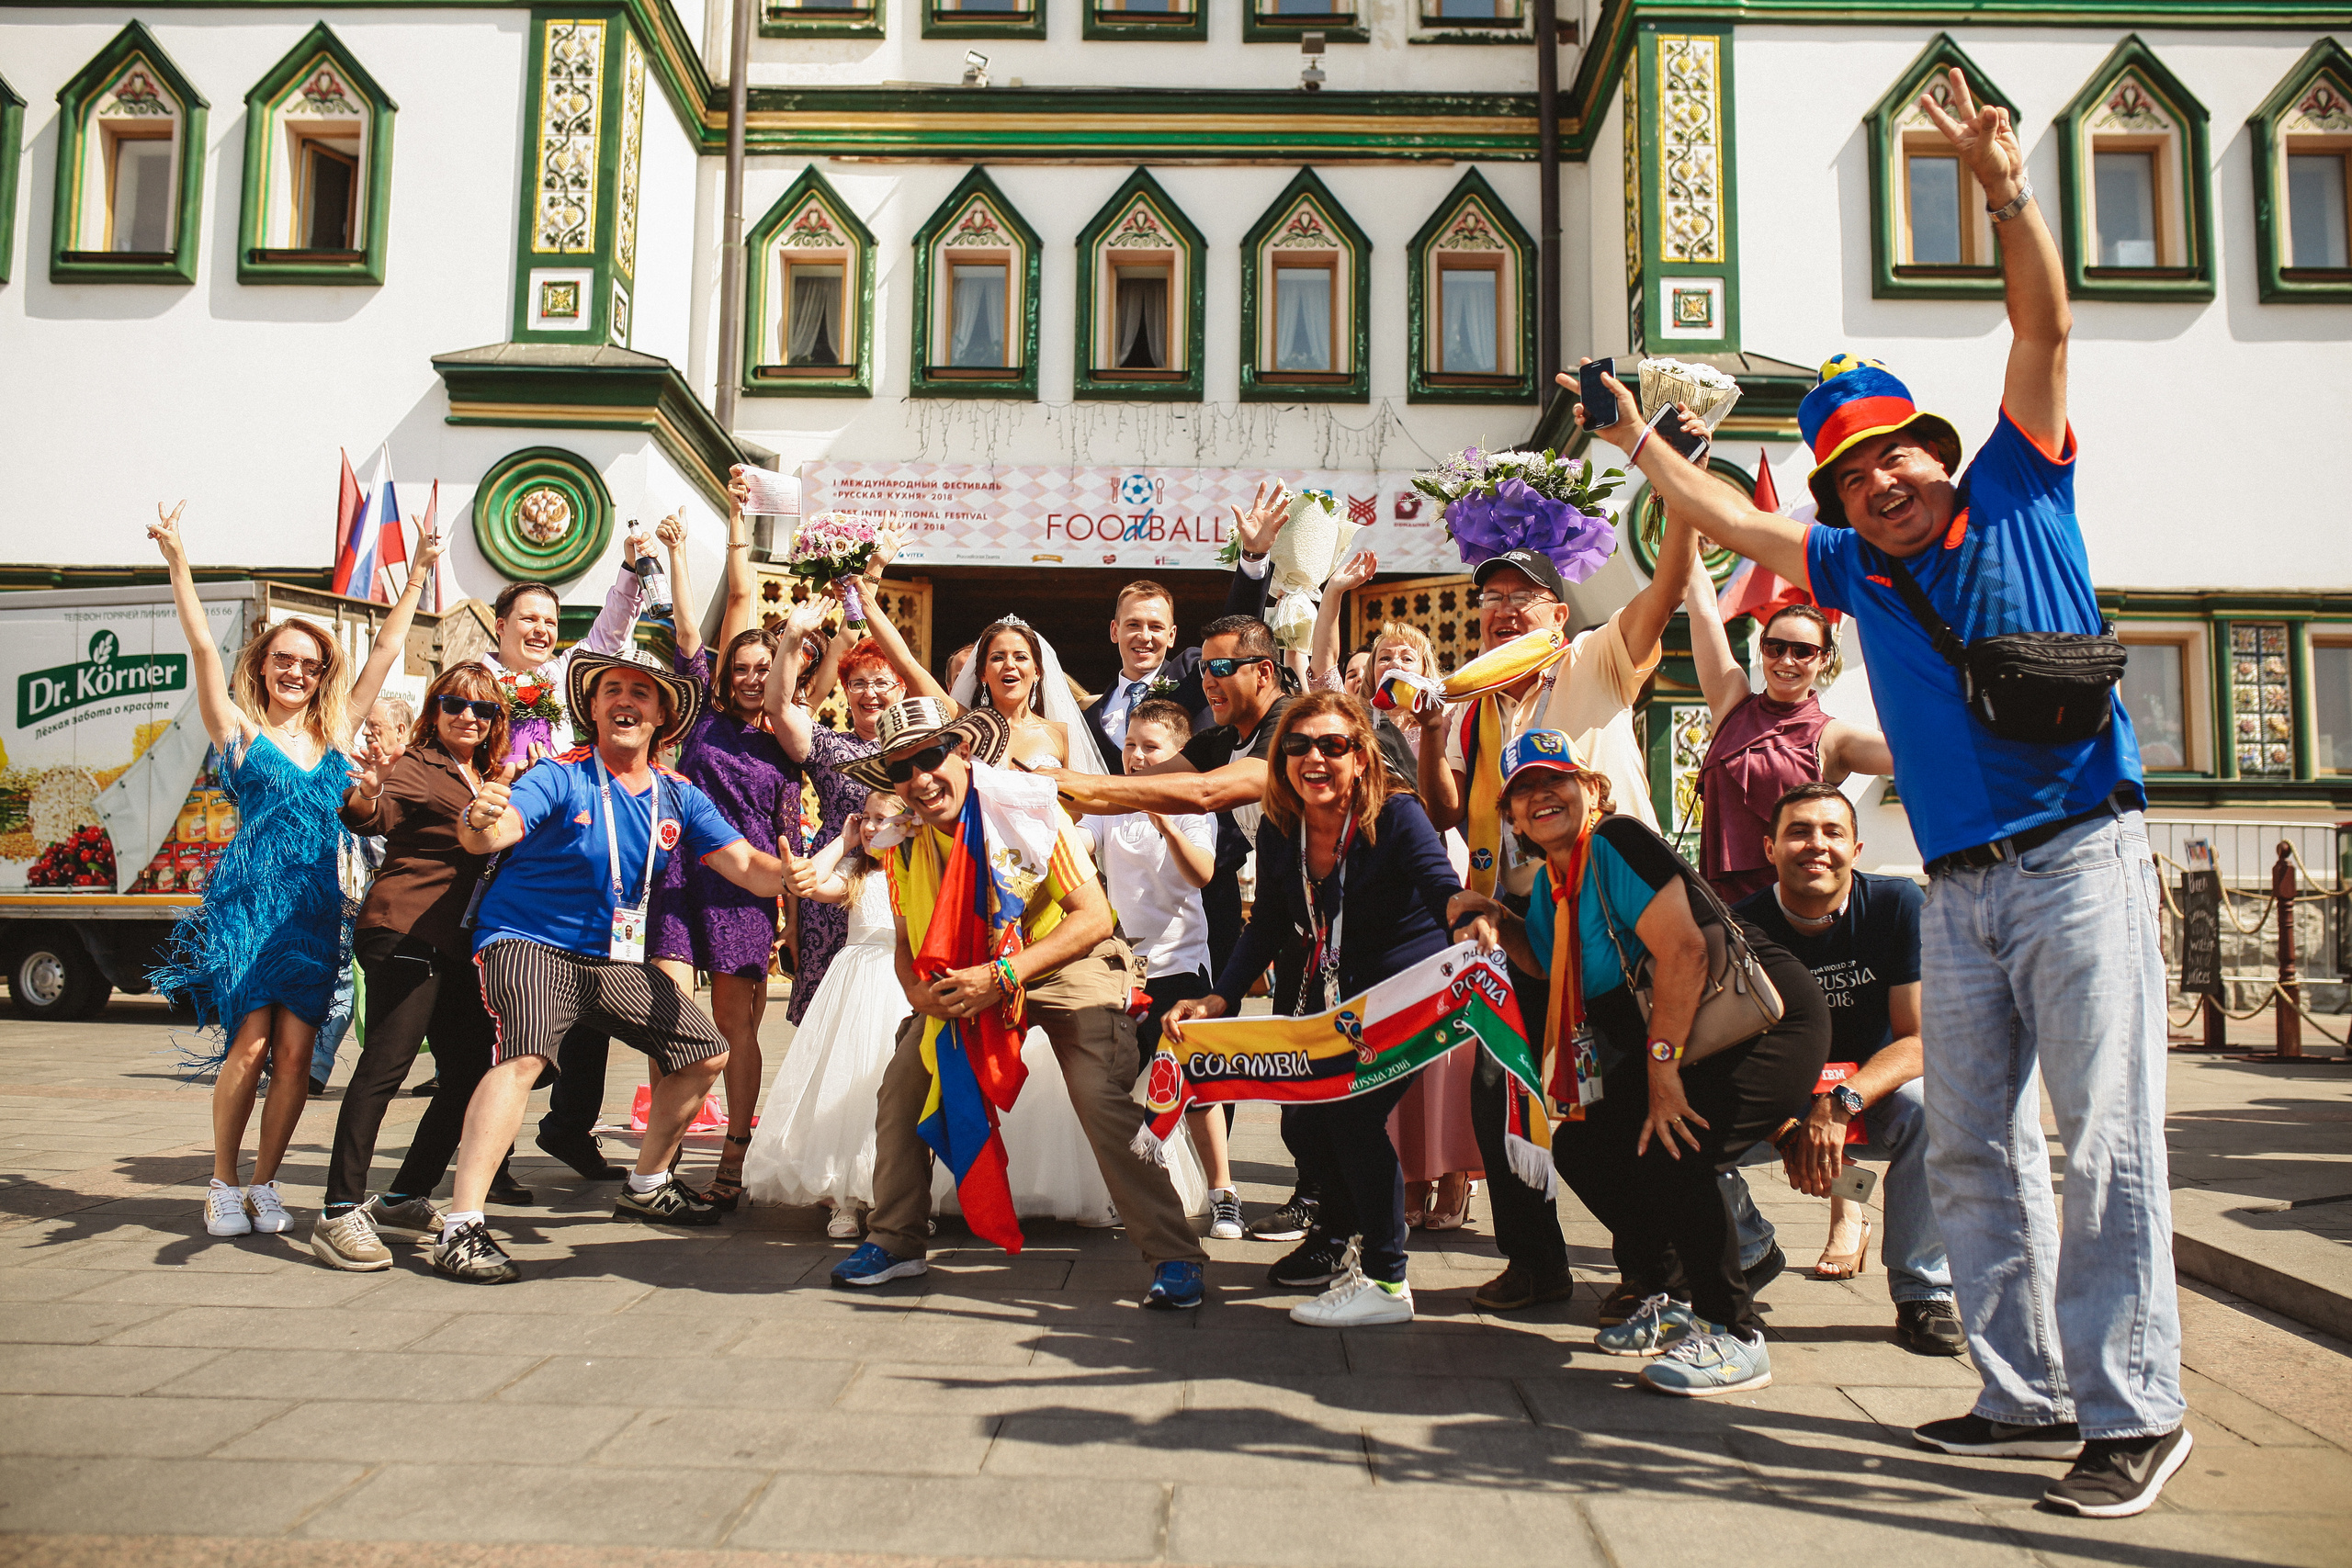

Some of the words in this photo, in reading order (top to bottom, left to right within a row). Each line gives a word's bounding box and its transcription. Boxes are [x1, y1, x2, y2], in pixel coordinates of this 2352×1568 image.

[840, 479, 938, 490] МЕЖДУНАРОДНЫЙ
[942, 480, 1002, 491] ФЕСТИВАЛЬ
[832, 491, 883, 500] «РУССКАЯ
[887, 491, 927, 501] КУХНЯ»
[931, 492, 954, 502] 2018
[862, 508, 941, 520] INTENTIONAL
[944, 511, 989, 521] FESTIVAL
[923, 523, 946, 531] 2018
[63, 612, 102, 622] ТЕЛЕФОН
[102, 610, 139, 621] ГОРЯЧЕЙ
[140, 609, 171, 619] ЛИНИИ
[210, 607, 220, 616] 65
[221, 606, 232, 615] 66
[28, 677, 71, 716] Dr.
[76, 663, 177, 701] Körner
[35, 720, 70, 739] Лёгкая
[72, 707, 112, 726] забота
[115, 705, 121, 715] о
[123, 701, 169, 715] красоте
[1825, 990, 1855, 1008] 018
[1189, 1050, 1314, 1077] COLOMBIA
[1347, 1071, 1387, 1092] RUSSIA
[1385, 1058, 1411, 1077] 2018
[1821, 1068, 1847, 1081] IBM
